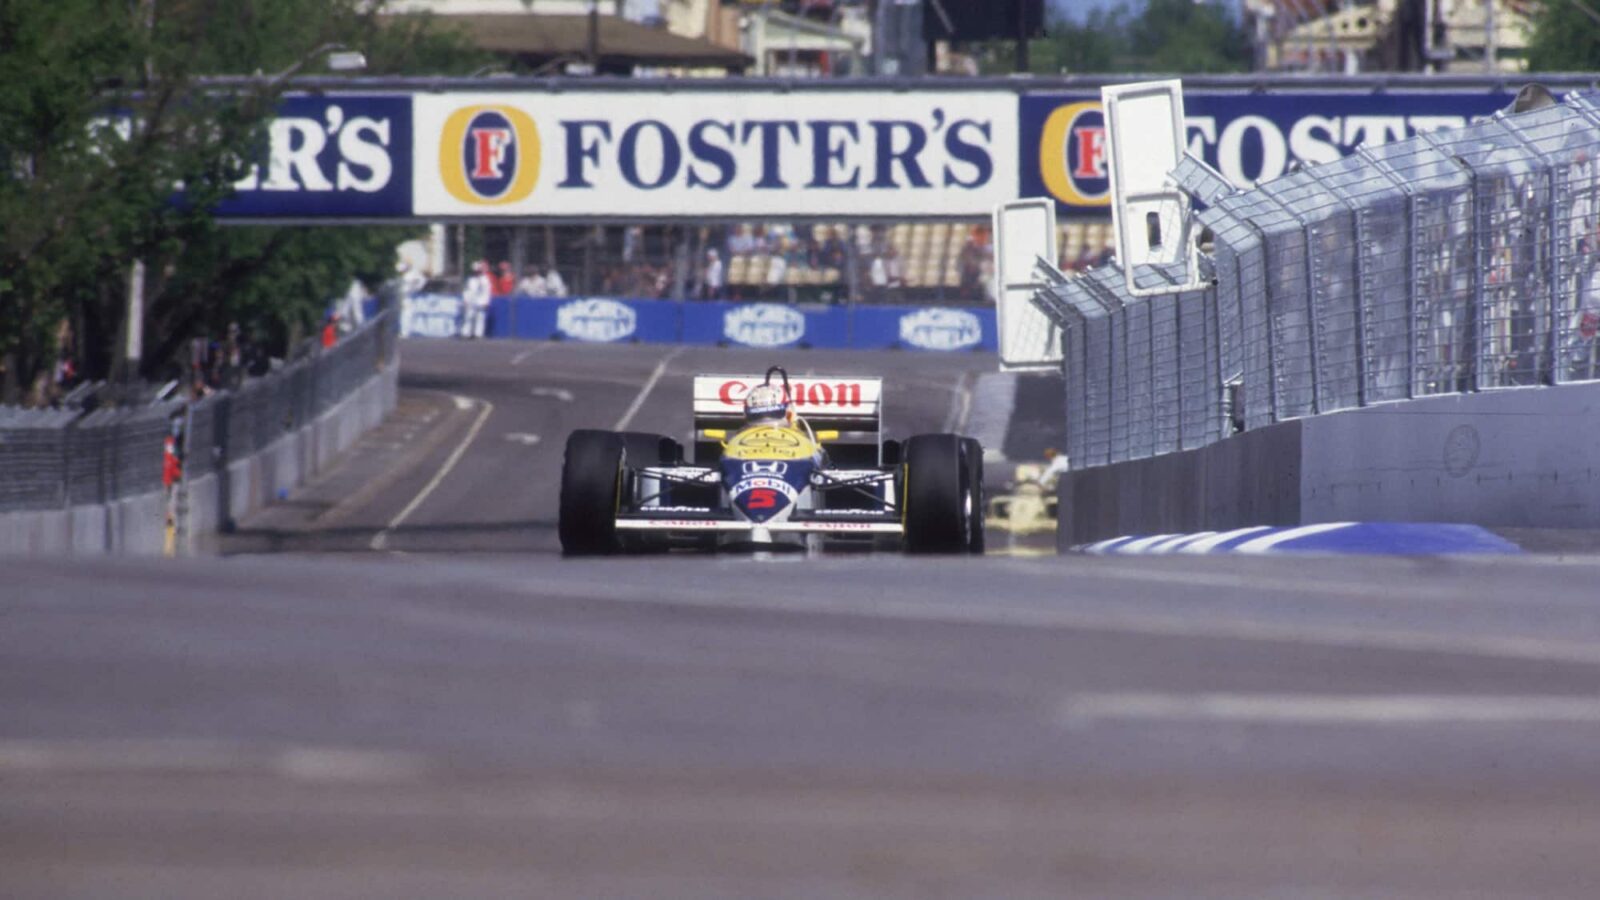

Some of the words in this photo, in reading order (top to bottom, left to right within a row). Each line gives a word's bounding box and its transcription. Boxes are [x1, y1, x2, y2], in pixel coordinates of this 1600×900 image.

[556, 108, 994, 190] FOSTER'S
[719, 380, 861, 408] Cnon
[735, 477, 792, 495] Mobil
[747, 488, 778, 510] 5
